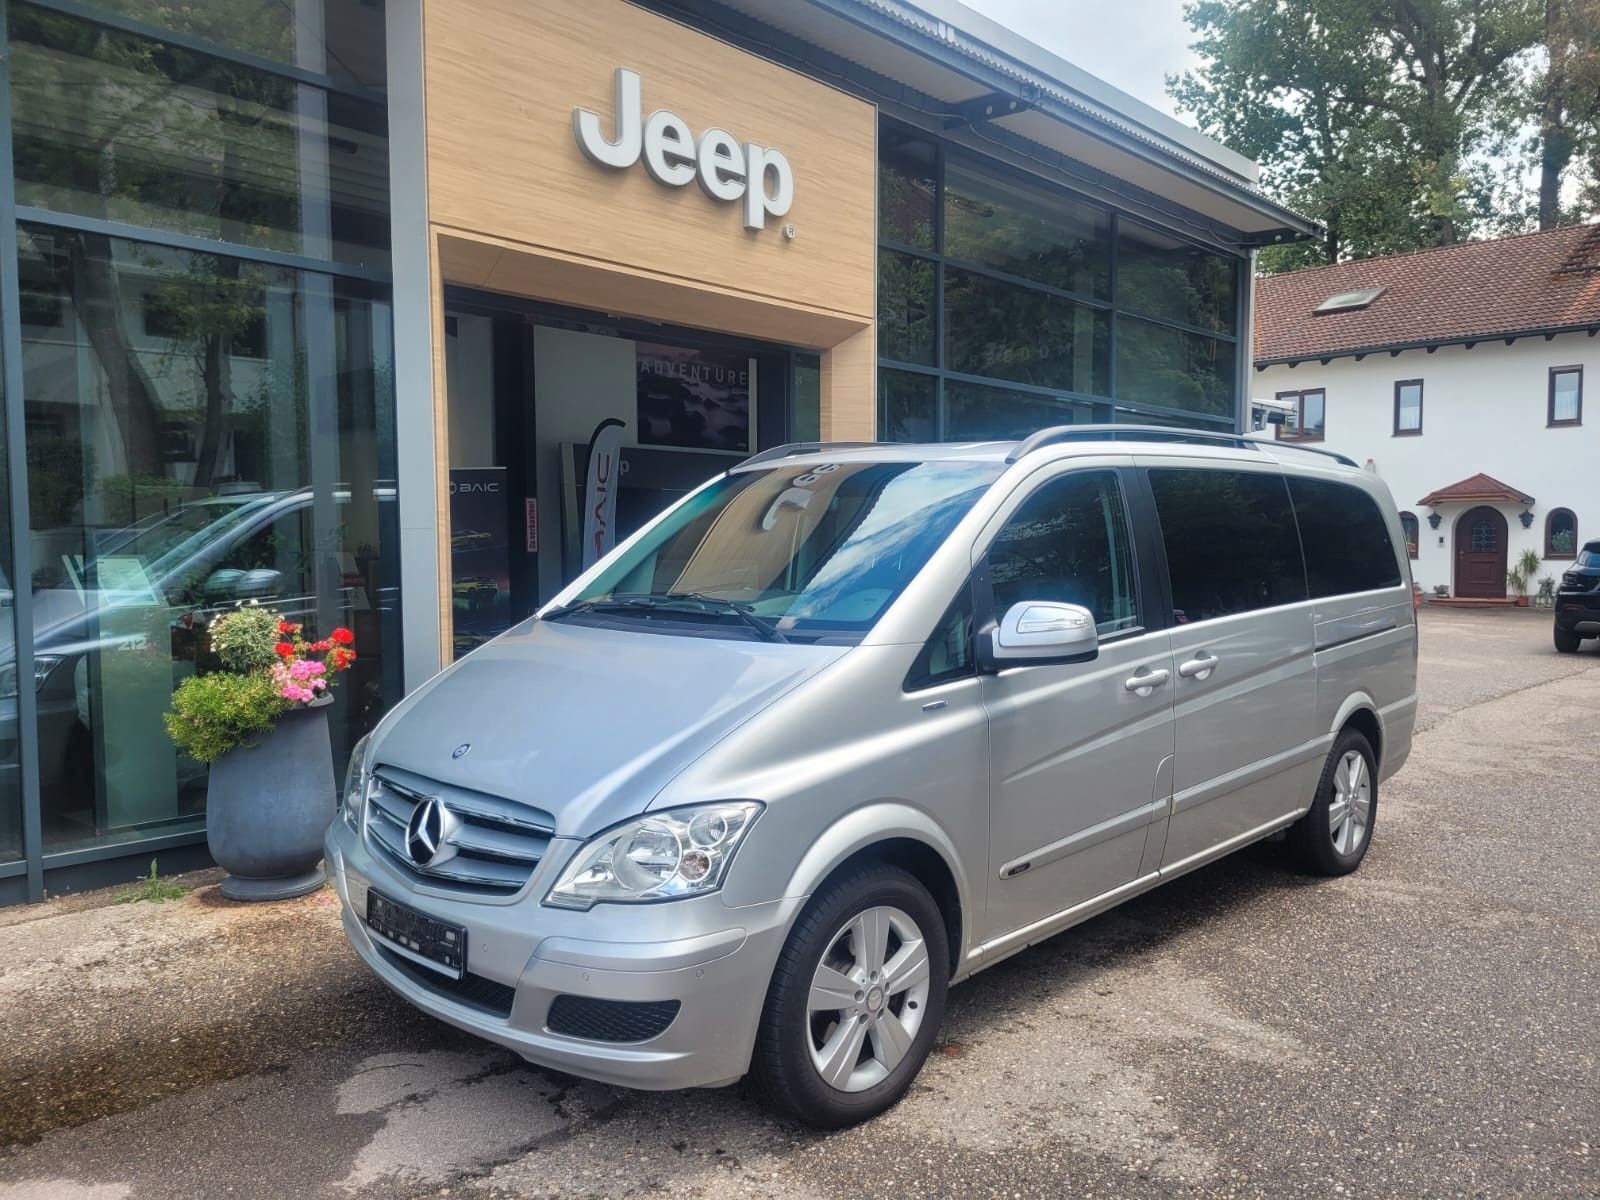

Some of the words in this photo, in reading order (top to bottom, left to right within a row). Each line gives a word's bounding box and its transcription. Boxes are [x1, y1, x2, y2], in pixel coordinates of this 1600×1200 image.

[572, 67, 794, 231] Jeep
[640, 359, 748, 386] ADVENTURE
[459, 483, 500, 493] BAIC
